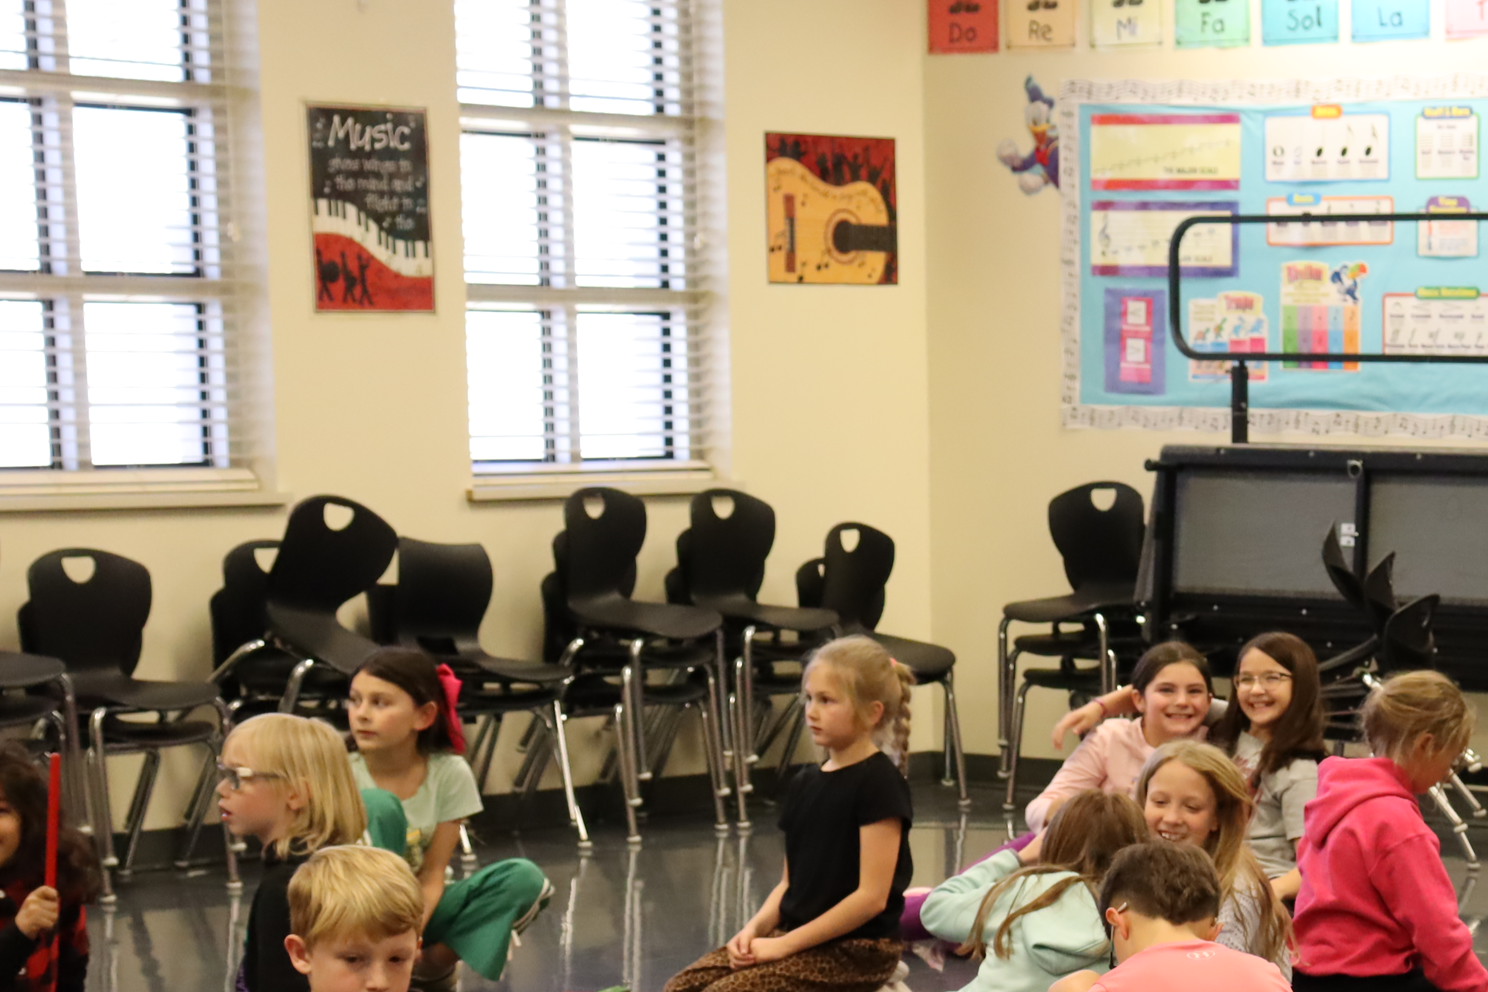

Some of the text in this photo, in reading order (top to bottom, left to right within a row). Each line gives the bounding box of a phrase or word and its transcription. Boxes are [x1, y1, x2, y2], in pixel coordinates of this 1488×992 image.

[1200, 12, 1225, 35] Fa
[1286, 6, 1323, 32] Sol
[1377, 7, 1404, 28] La
[949, 23, 977, 43] Do
[1028, 20, 1053, 40] Re
[1116, 18, 1139, 40] Mi
[327, 112, 411, 151] Music
